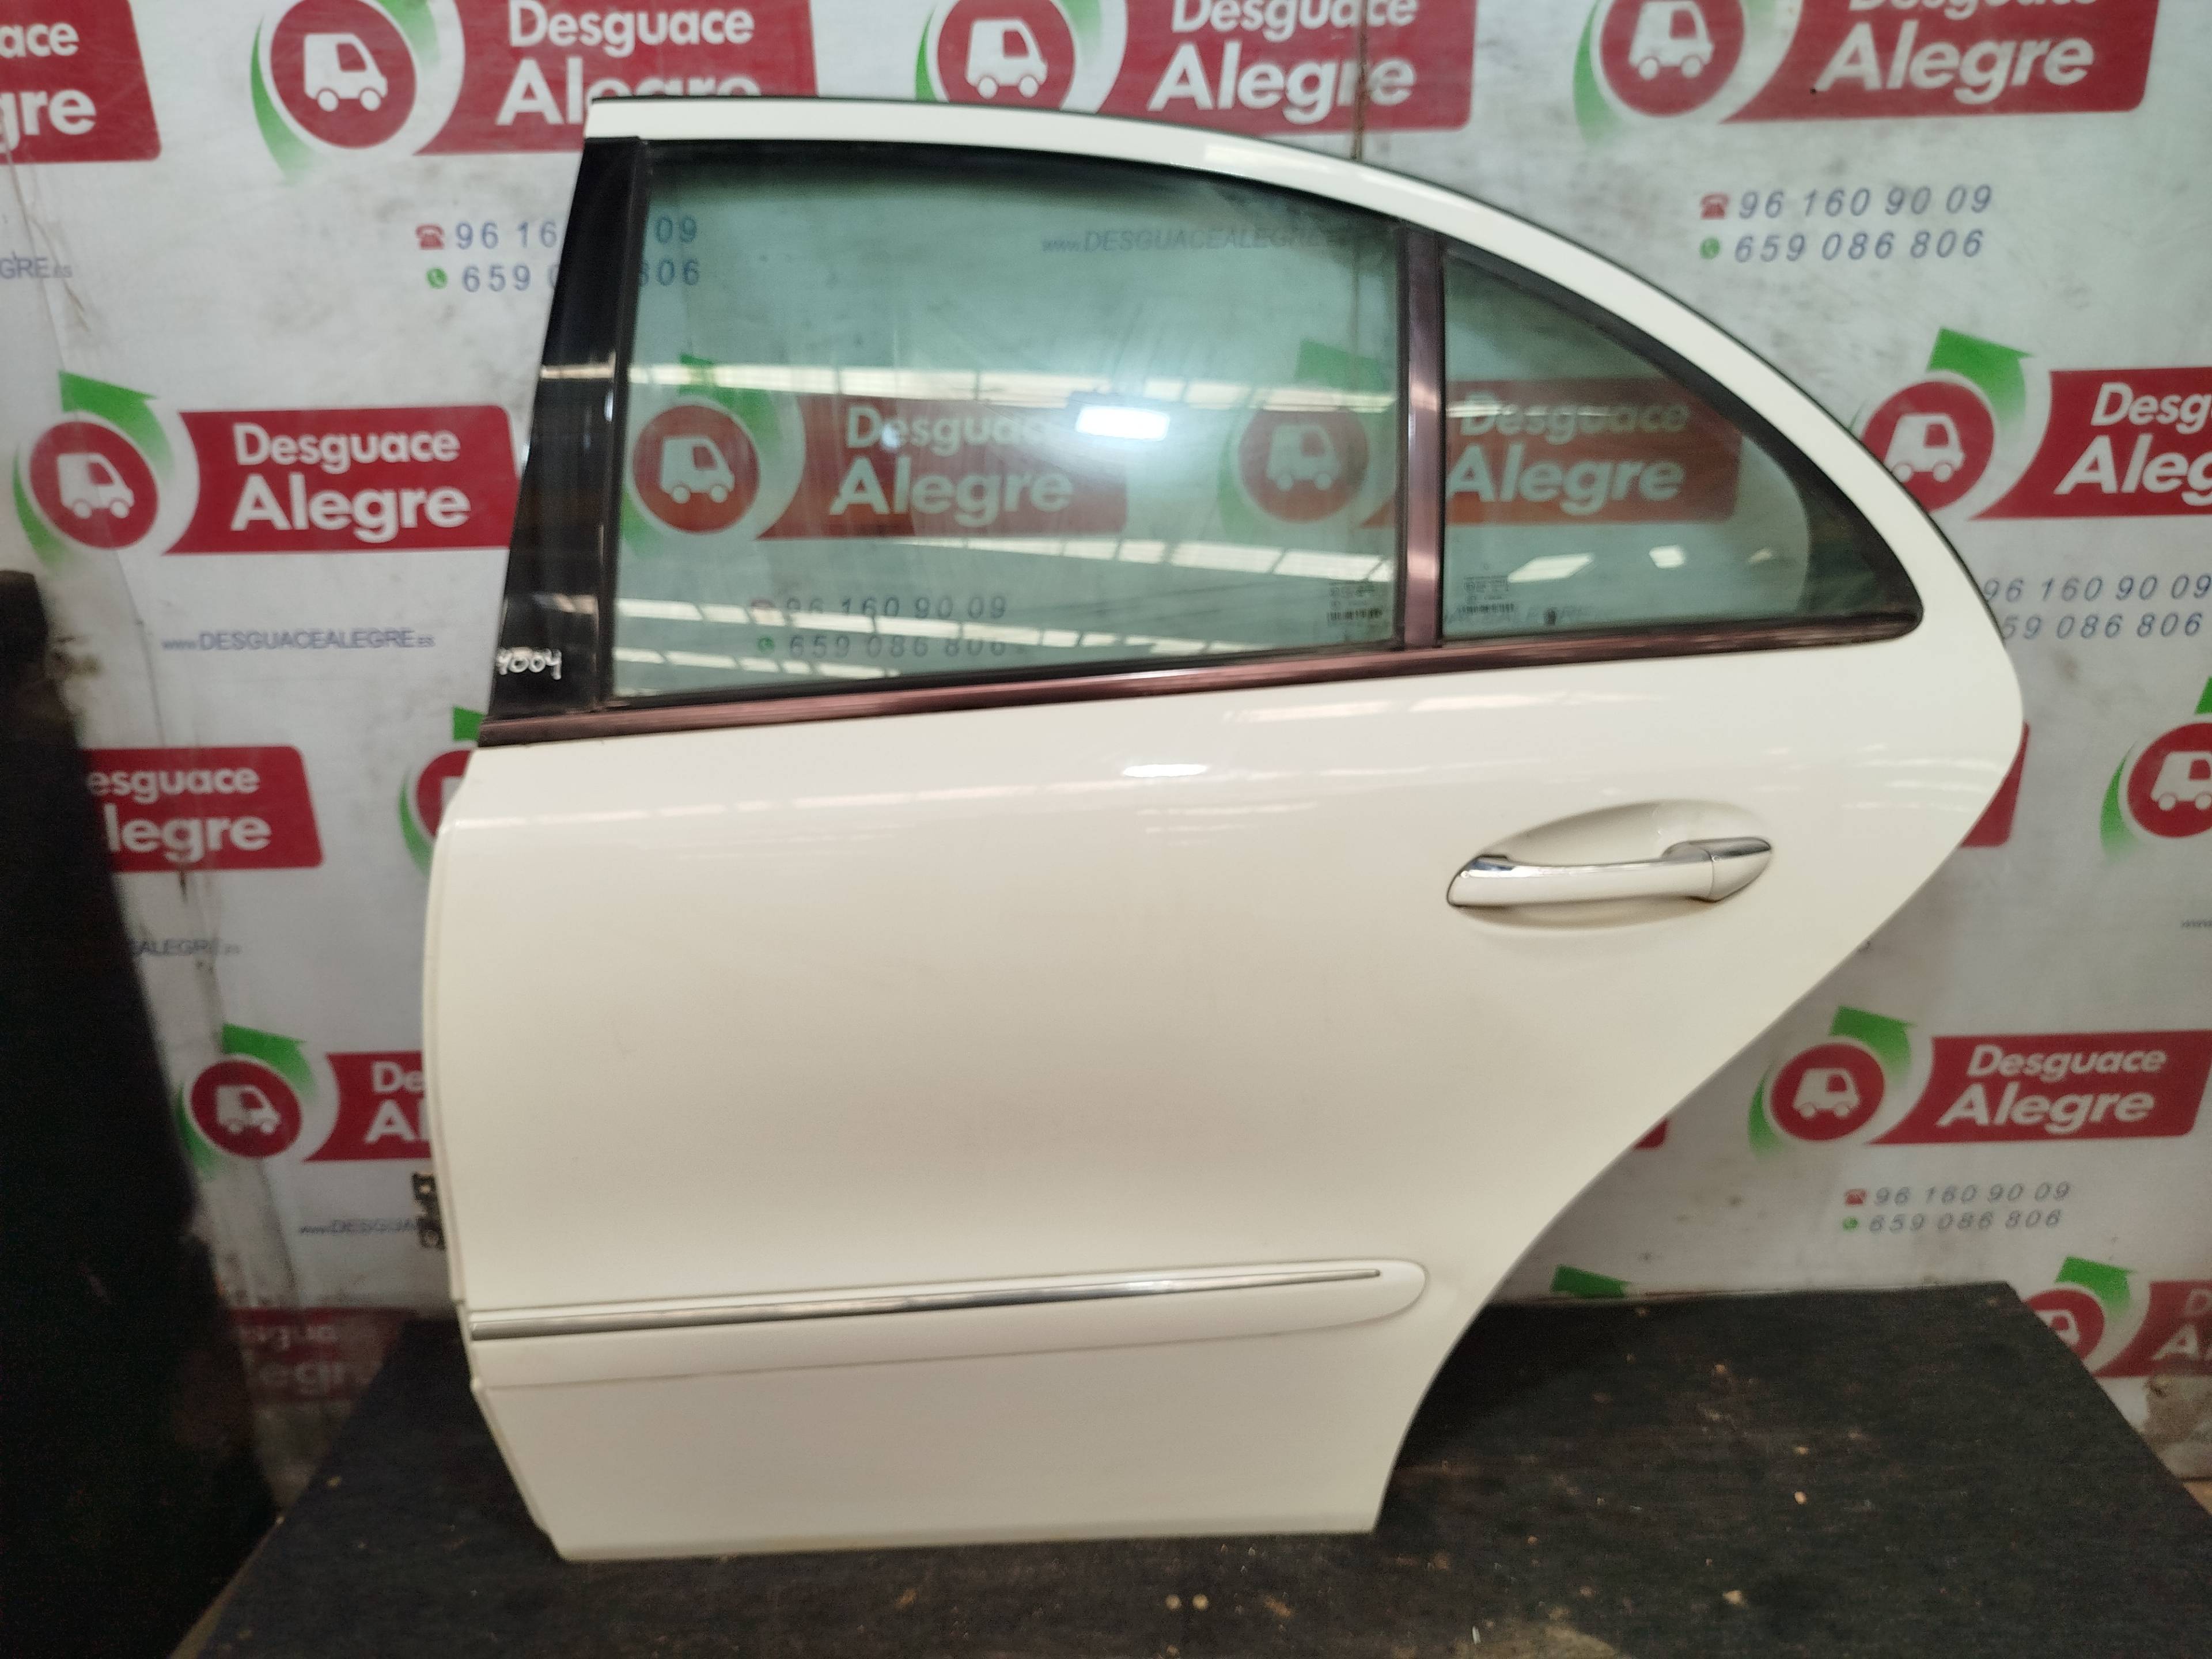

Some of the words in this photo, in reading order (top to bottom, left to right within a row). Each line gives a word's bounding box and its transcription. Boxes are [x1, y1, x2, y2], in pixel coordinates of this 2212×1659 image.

[509, 0, 755, 57] Desguace
[1148, 40, 1417, 125] Alegre
[1814, 20, 2095, 105] Alegre
[1739, 190, 1784, 219] 96
[1804, 188, 1871, 217] 160
[1885, 186, 1931, 215] 90
[1946, 184, 1993, 214] 09
[455, 221, 499, 249] 96
[655, 215, 698, 244] 09
[1734, 234, 1805, 263] 659
[1821, 232, 1895, 260] 086
[1910, 229, 1984, 259] 806
[463, 264, 532, 291] 659
[846, 405, 1066, 457] Desgua
[2090, 381, 2212, 435] Desg
[233, 422, 460, 474] Desguace
[830, 456, 1074, 528] Alegre
[1446, 441, 1687, 516] Alegre
[231, 471, 471, 544] Alegre
[914, 596, 954, 619] 90
[968, 594, 1006, 619] 09
[1983, 578, 2024, 603] 96
[2042, 577, 2103, 602] 160
[2116, 575, 2158, 601] 90
[2171, 574, 2211, 600] 09
[2055, 613, 2123, 639] 086
[2136, 612, 2203, 638] 806
[104, 802, 272, 863] legre
[1967, 1044, 2167, 1083] Desguace
[1936, 1081, 2155, 1135] Alegre
[1988, 1183, 2025, 1202] 90
